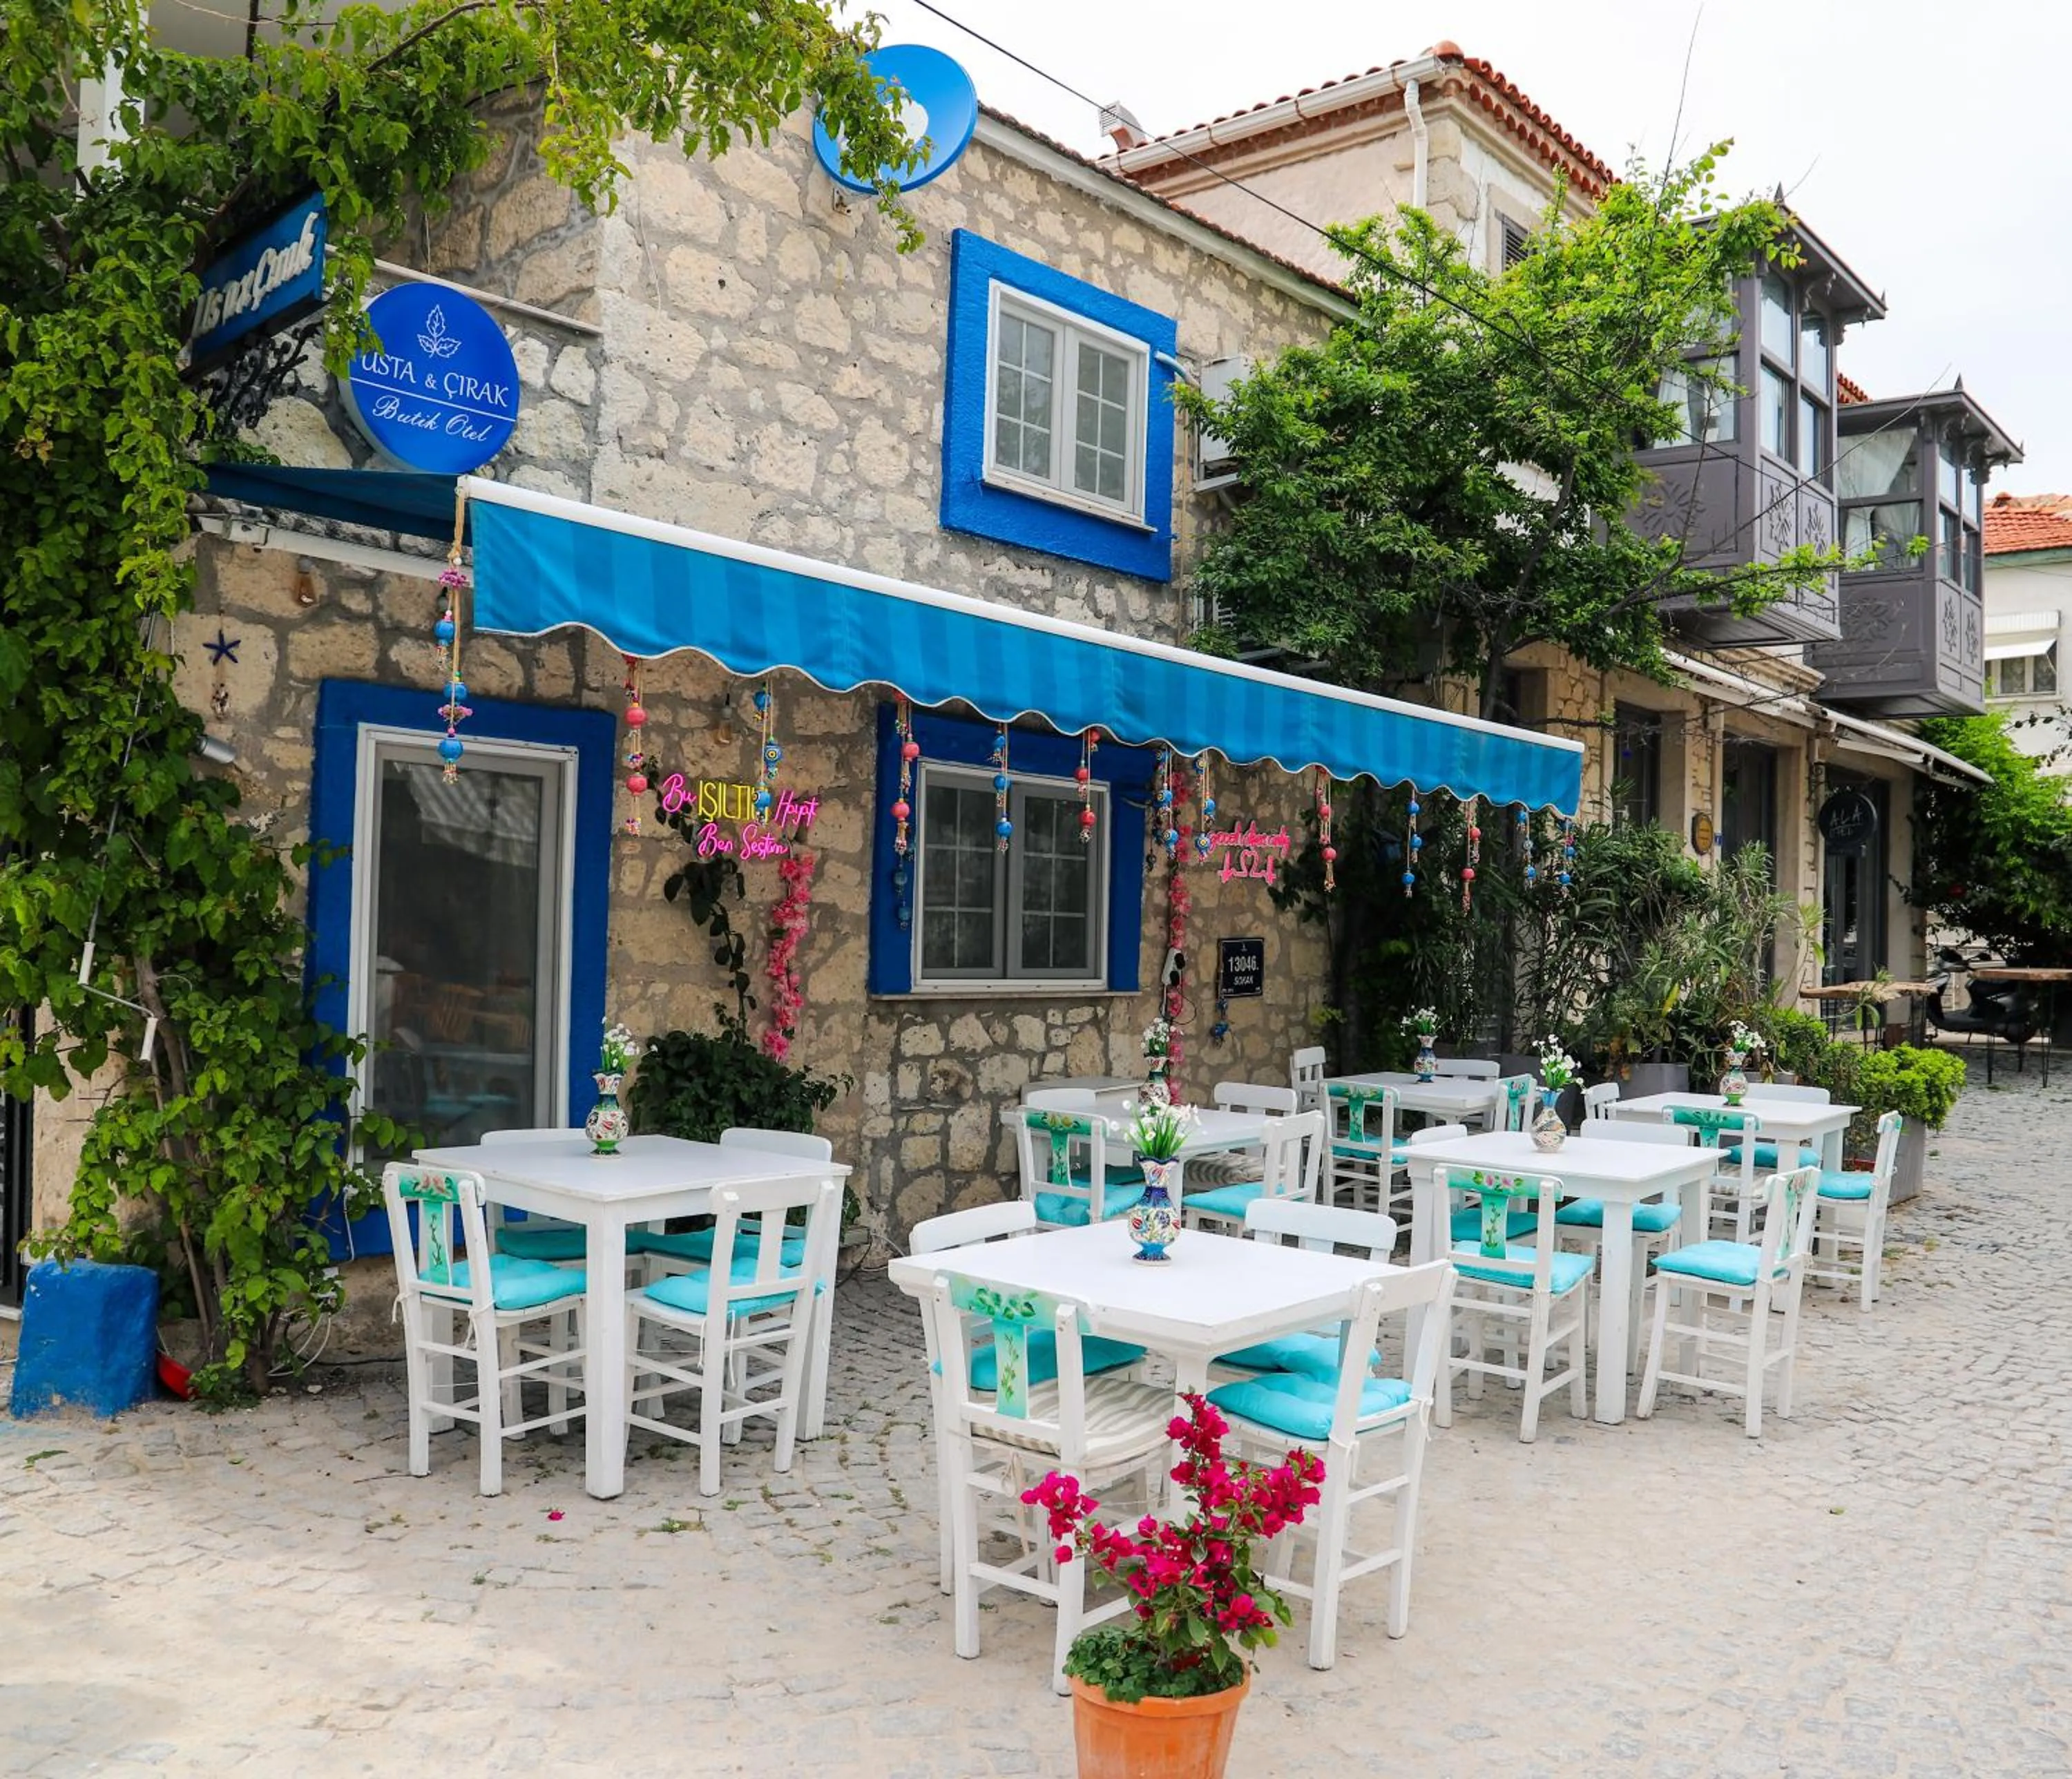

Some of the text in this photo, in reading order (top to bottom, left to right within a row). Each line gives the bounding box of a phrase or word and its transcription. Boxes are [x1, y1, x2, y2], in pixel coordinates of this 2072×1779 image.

[361, 351, 510, 407] USTA & ÇIRAK
[372, 394, 493, 442] Butik Otel
[662, 773, 698, 813] Bu
[697, 822, 733, 858] Ben
